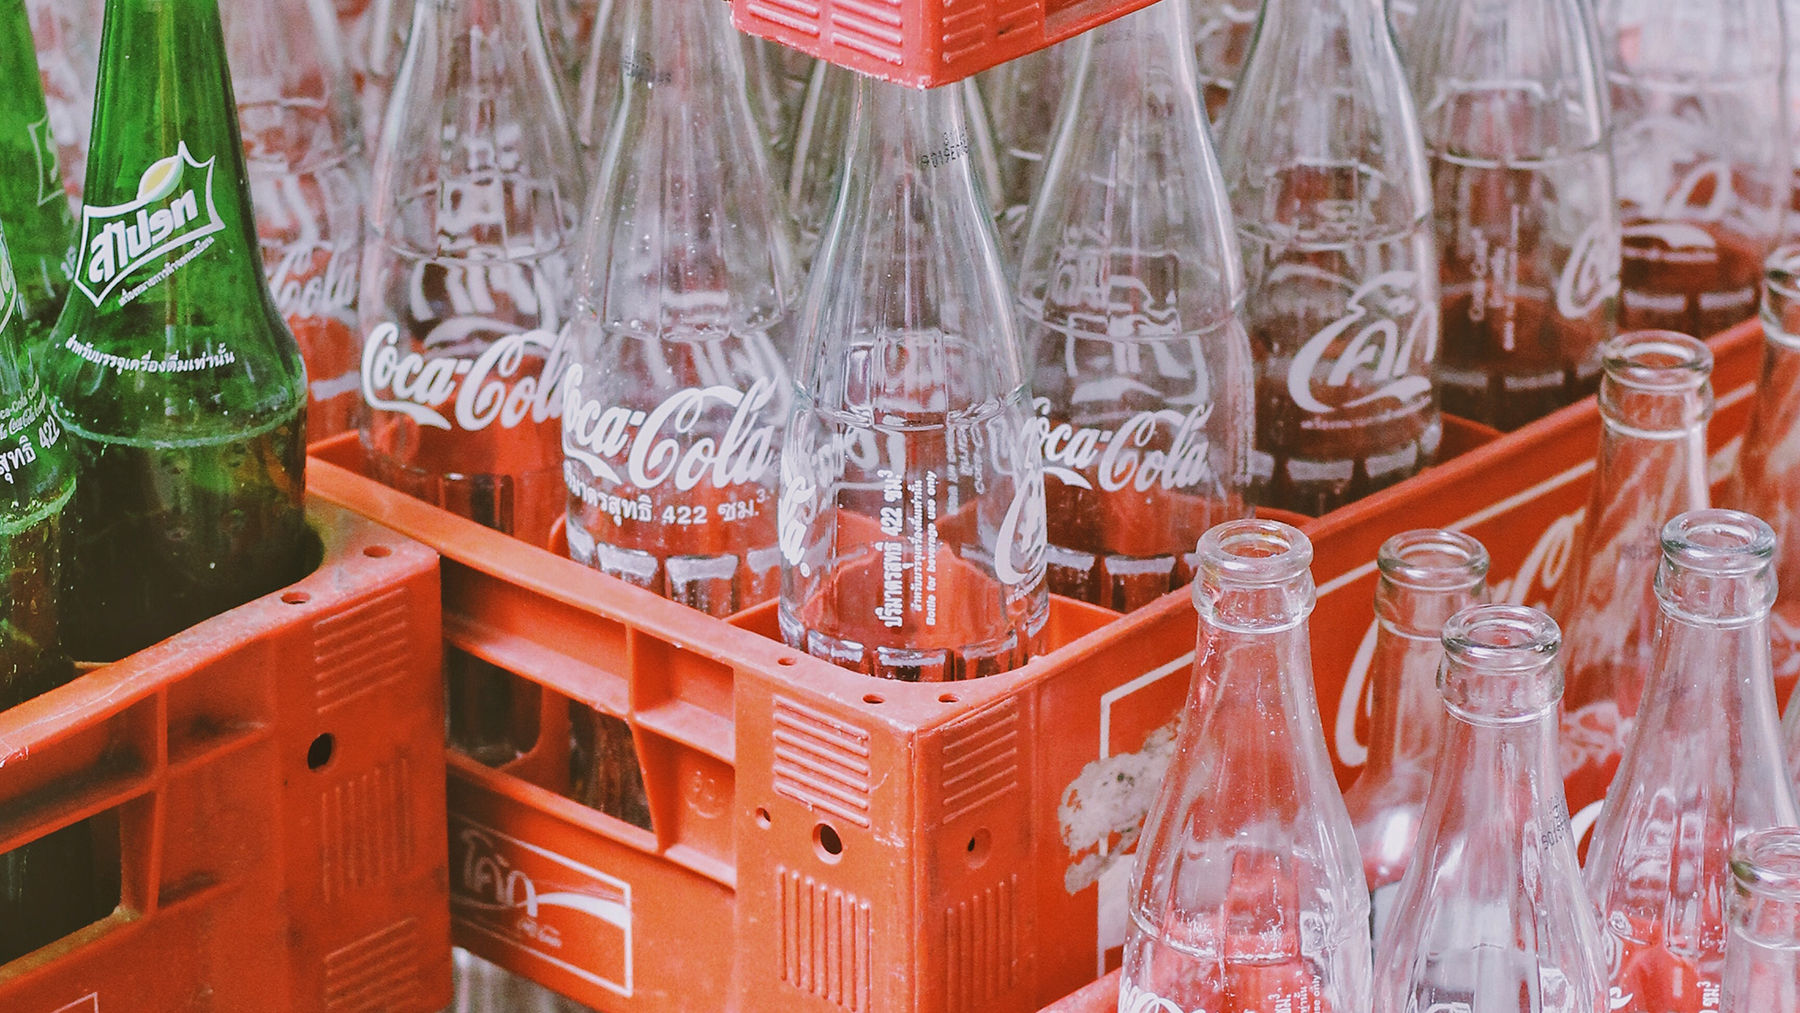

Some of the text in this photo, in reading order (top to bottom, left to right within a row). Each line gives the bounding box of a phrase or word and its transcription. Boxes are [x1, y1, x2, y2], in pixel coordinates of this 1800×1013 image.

[38, 414, 61, 449] 422
[561, 362, 779, 492] Coca-Cola
[661, 504, 708, 525] 422
[880, 506, 904, 538] 422
[926, 470, 938, 627] Bottle for beverage use only
[1312, 974, 1322, 997] only
